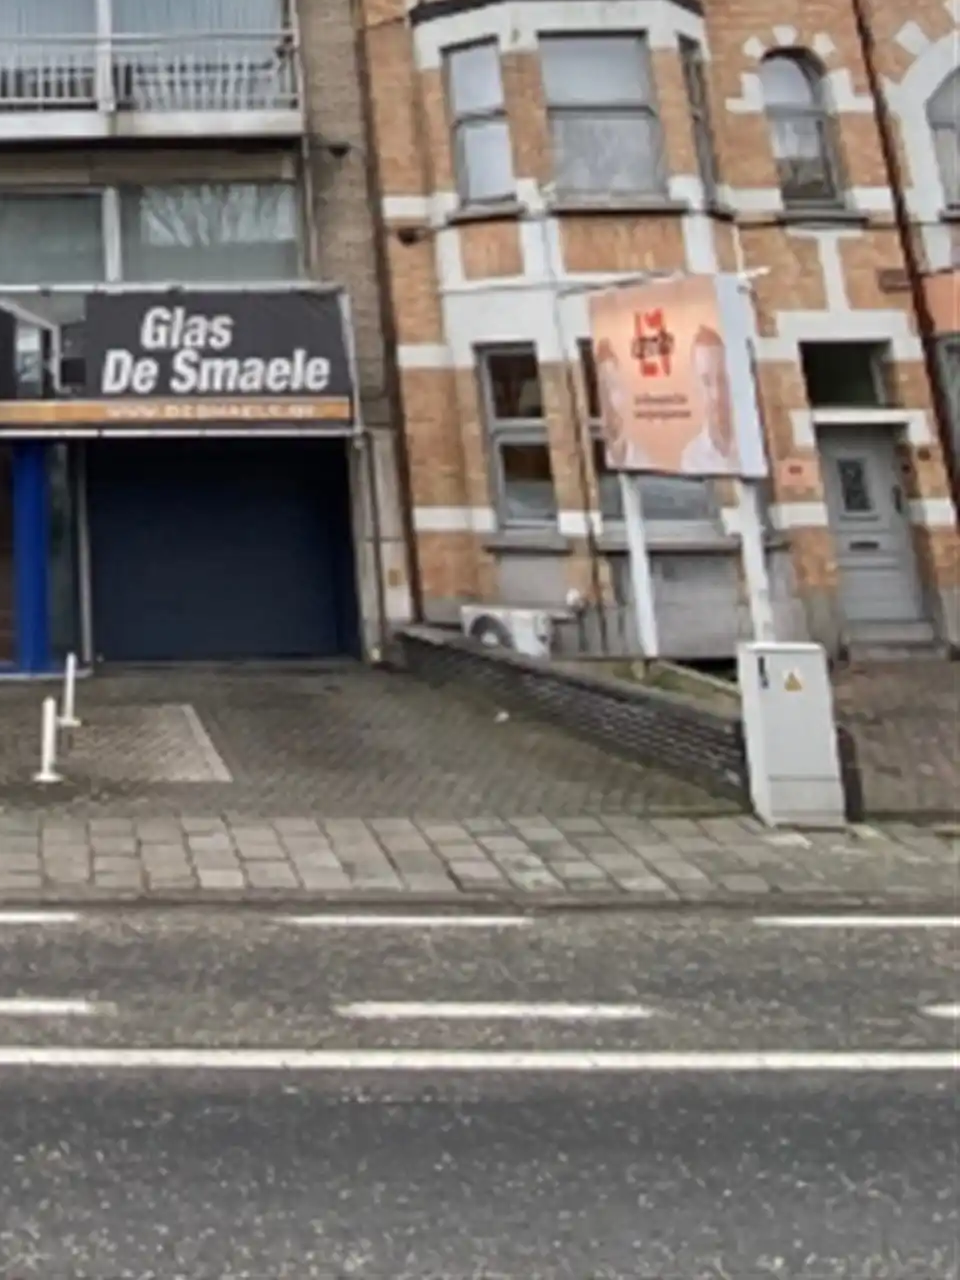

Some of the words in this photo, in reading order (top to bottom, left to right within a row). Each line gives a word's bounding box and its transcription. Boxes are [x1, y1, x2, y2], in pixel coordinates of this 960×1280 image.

[141, 306, 234, 349] Glas
[102, 349, 159, 394] De
[170, 349, 330, 393] Smaele
